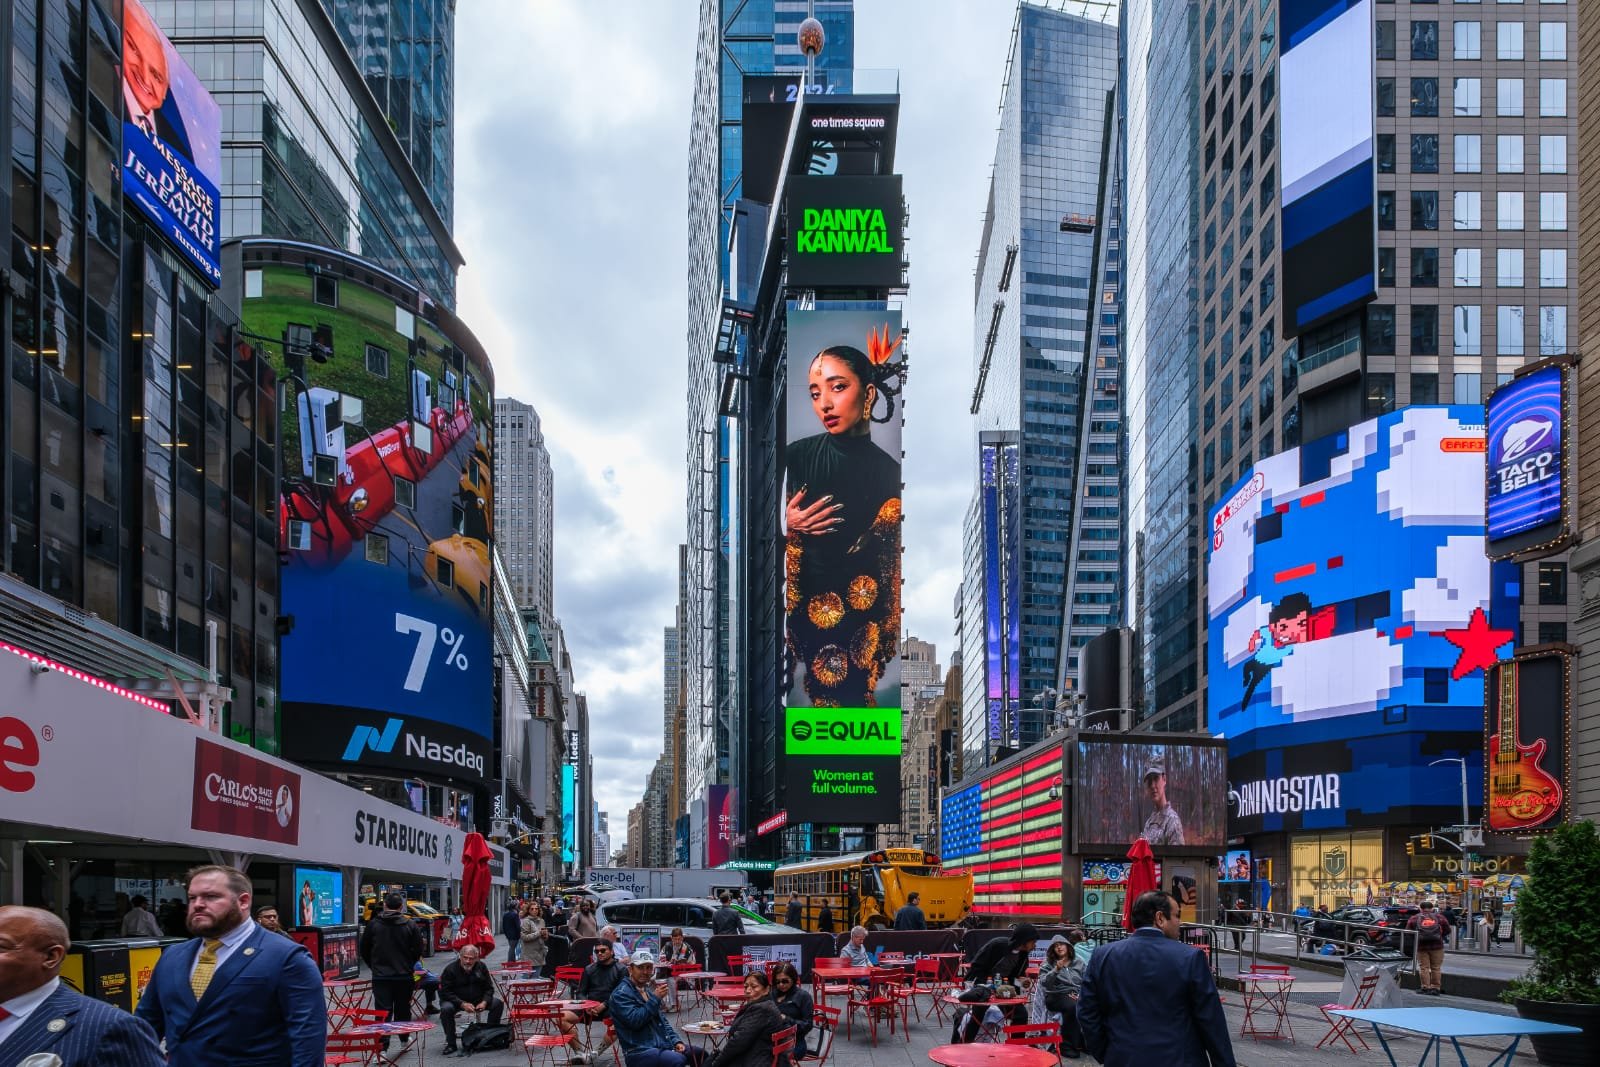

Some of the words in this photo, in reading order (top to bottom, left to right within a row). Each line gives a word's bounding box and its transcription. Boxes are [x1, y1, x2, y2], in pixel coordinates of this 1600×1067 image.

[811, 118, 828, 128] one
[829, 117, 853, 128] times
[854, 118, 885, 131] square
[138, 119, 150, 139] A
[152, 135, 214, 211] MESSAGE
[124, 148, 215, 253] JEREMIAH
[159, 168, 214, 237] DAVID
[175, 172, 214, 223] FROM
[804, 208, 886, 231] DANIYA
[172, 224, 212, 273] Turning
[213, 267, 221, 280] P
[797, 231, 894, 253] KANWAL
[1445, 441, 1485, 449] BARRI
[1497, 451, 1553, 481] TACO
[1500, 467, 1554, 495] BELL
[816, 720, 896, 742] EQUAL
[405, 733, 484, 778] Nasdaq
[570, 732, 579, 760] Locker
[205, 773, 258, 802] CARLO'S
[811, 782, 830, 794] full
[831, 782, 878, 794] volume.
[813, 769, 860, 782] Women
[861, 770, 874, 782] at
[1494, 794, 1525, 808] Hard
[1527, 793, 1558, 807] Rock
[355, 809, 438, 859] STARBUCKS
[755, 862, 772, 870] Here
[889, 852, 908, 862] SCHOOL
[910, 852, 922, 863] BUS
[590, 872, 635, 882] Sher-Del
